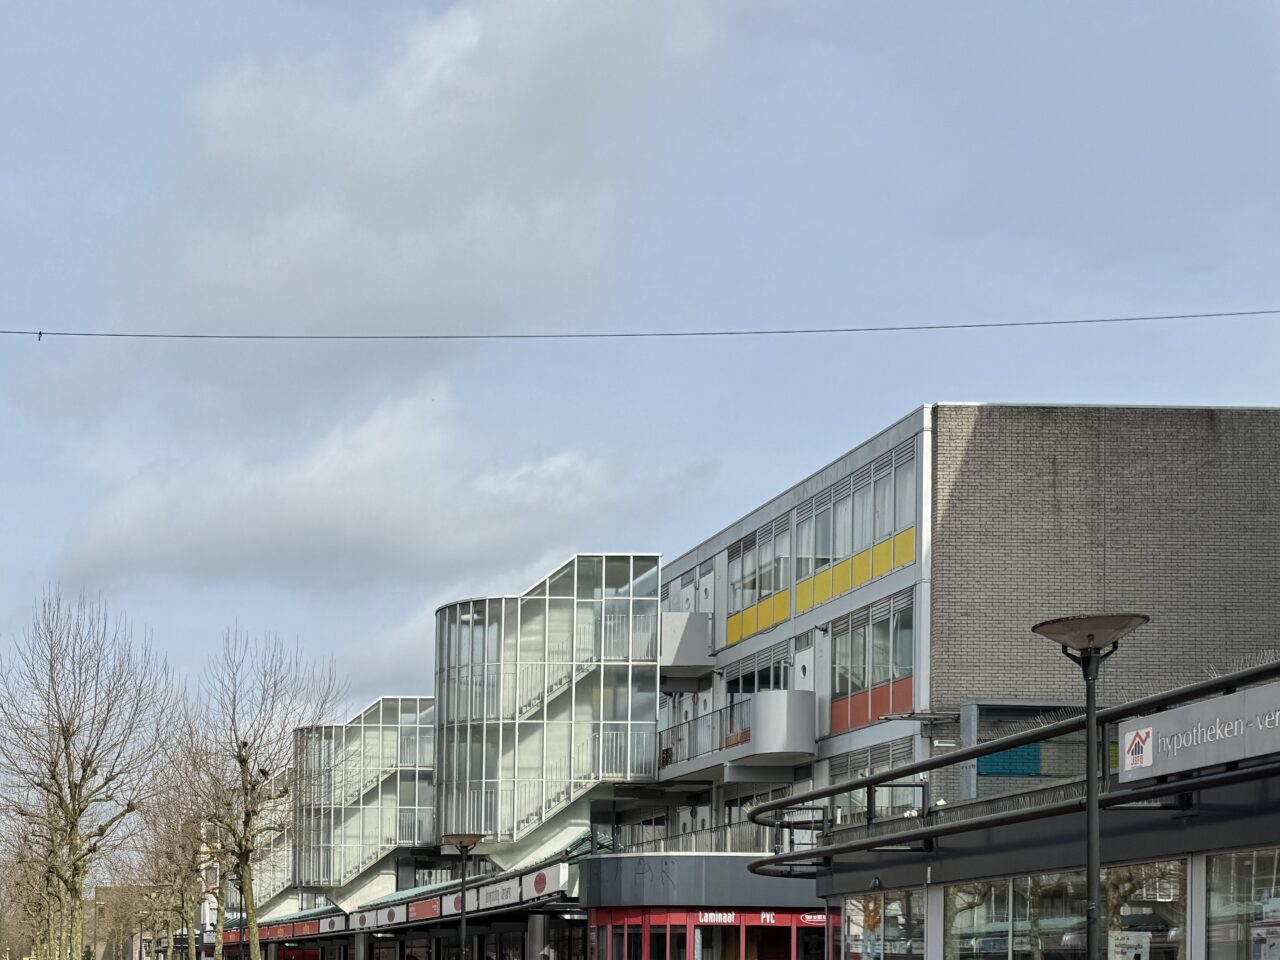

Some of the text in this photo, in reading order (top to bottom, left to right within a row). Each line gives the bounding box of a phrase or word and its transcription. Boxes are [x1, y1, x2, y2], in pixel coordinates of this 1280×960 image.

[1157, 717, 1244, 758] hypotheken
[699, 911, 775, 923] Laminaat PVC
